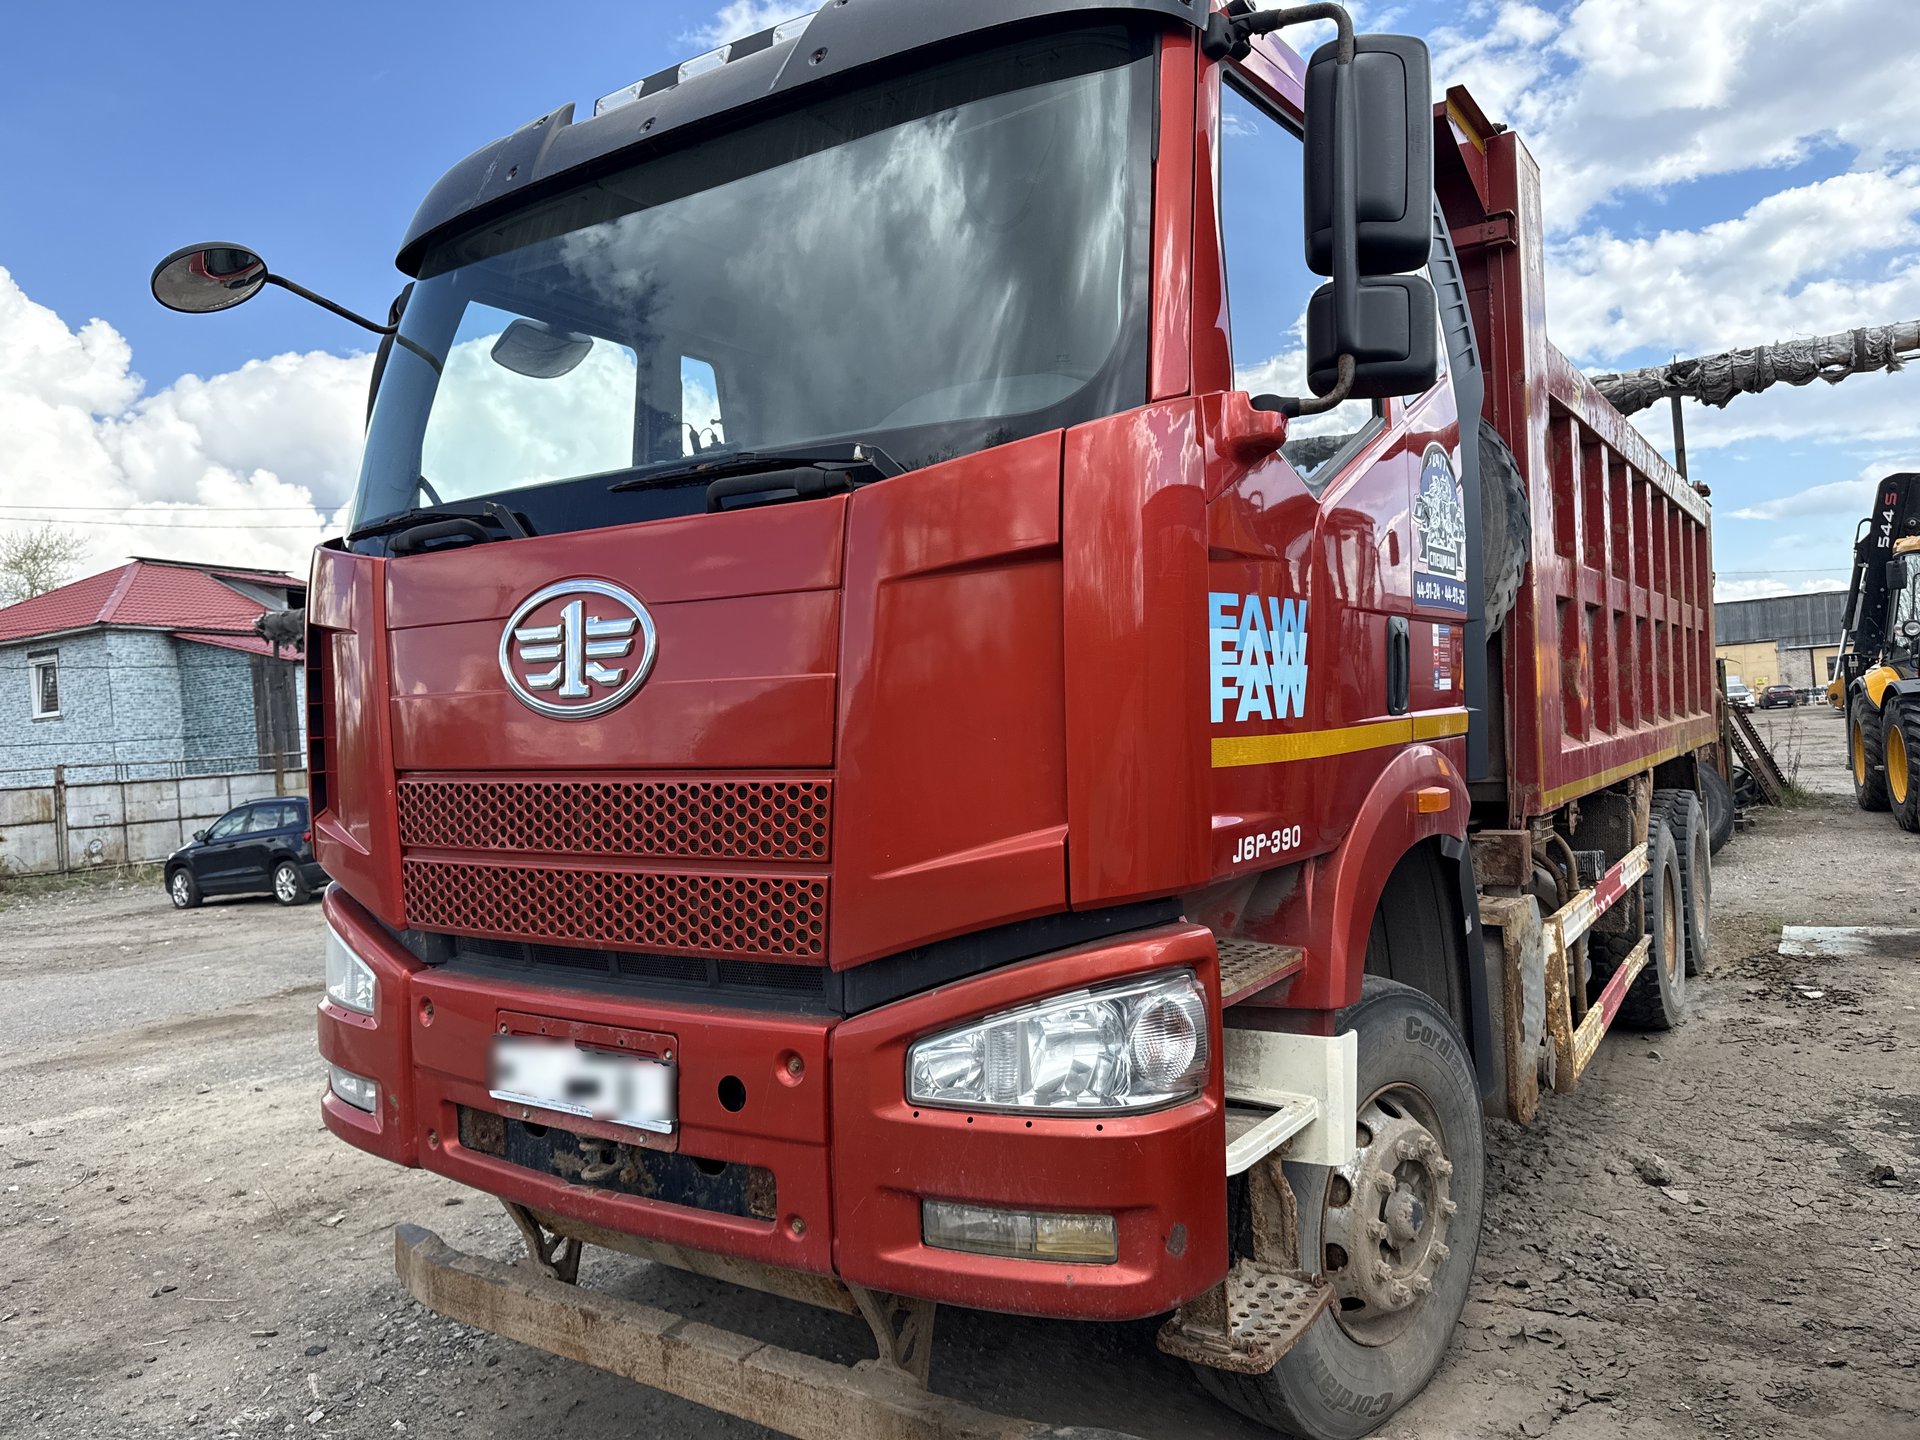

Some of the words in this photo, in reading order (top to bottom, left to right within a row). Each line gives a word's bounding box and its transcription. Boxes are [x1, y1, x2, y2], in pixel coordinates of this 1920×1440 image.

[1877, 509, 1894, 548] 544
[1210, 664, 1309, 723] FAW
[1232, 824, 1301, 864] J6P-390
